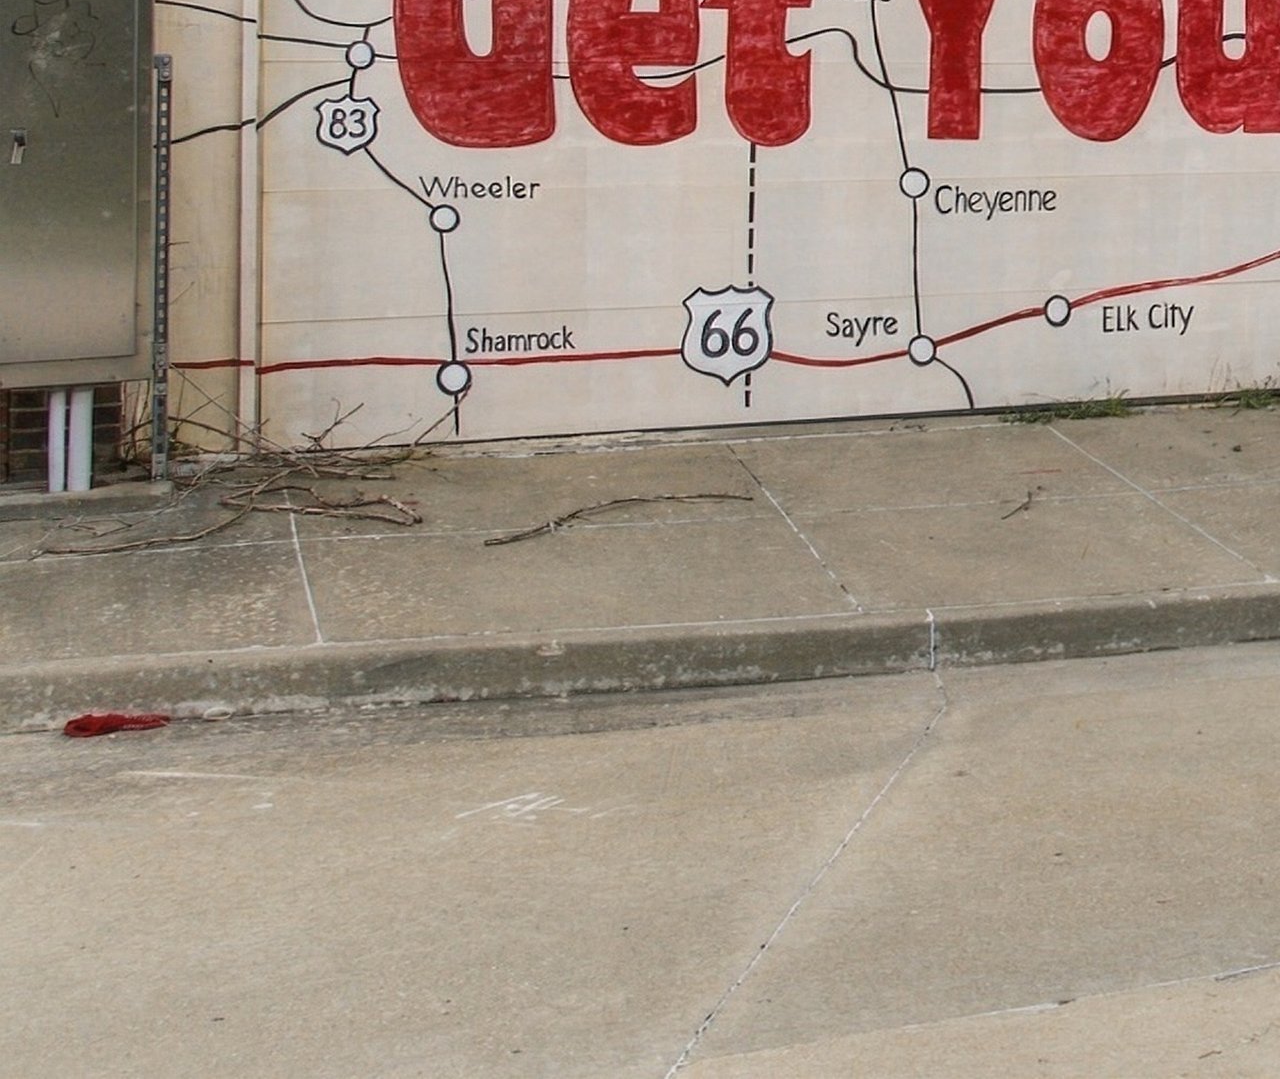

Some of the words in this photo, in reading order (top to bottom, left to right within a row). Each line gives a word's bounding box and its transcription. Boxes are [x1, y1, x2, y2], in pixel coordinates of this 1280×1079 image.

[327, 108, 368, 139] 83
[419, 176, 541, 200] Wheeler
[934, 184, 1058, 216] Cheyenne
[700, 308, 756, 358] 66
[826, 313, 899, 341] Sayre
[1147, 302, 1196, 336] City
[466, 325, 576, 353] Shamrock
